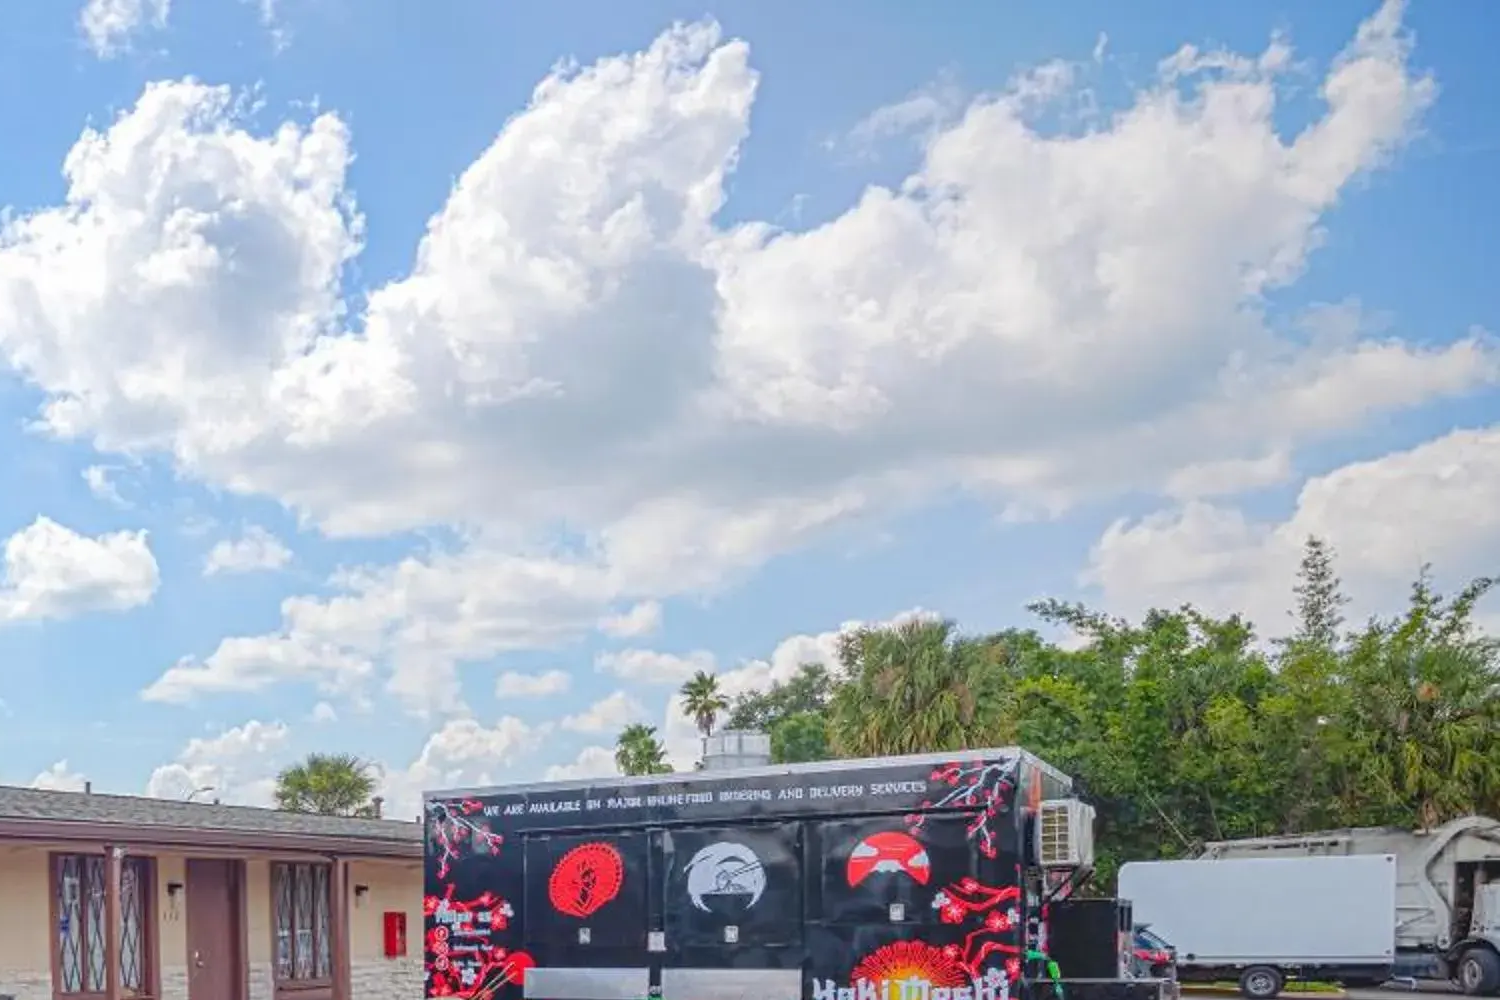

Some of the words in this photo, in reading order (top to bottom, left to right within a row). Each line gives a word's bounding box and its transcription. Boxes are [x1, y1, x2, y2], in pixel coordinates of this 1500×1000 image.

[484, 805, 500, 817] WE
[503, 804, 525, 816] ARE
[529, 799, 581, 814] AVAILABLE
[778, 786, 803, 800] AND
[809, 784, 863, 798] DELIVERY
[871, 780, 928, 796] SERVICES
